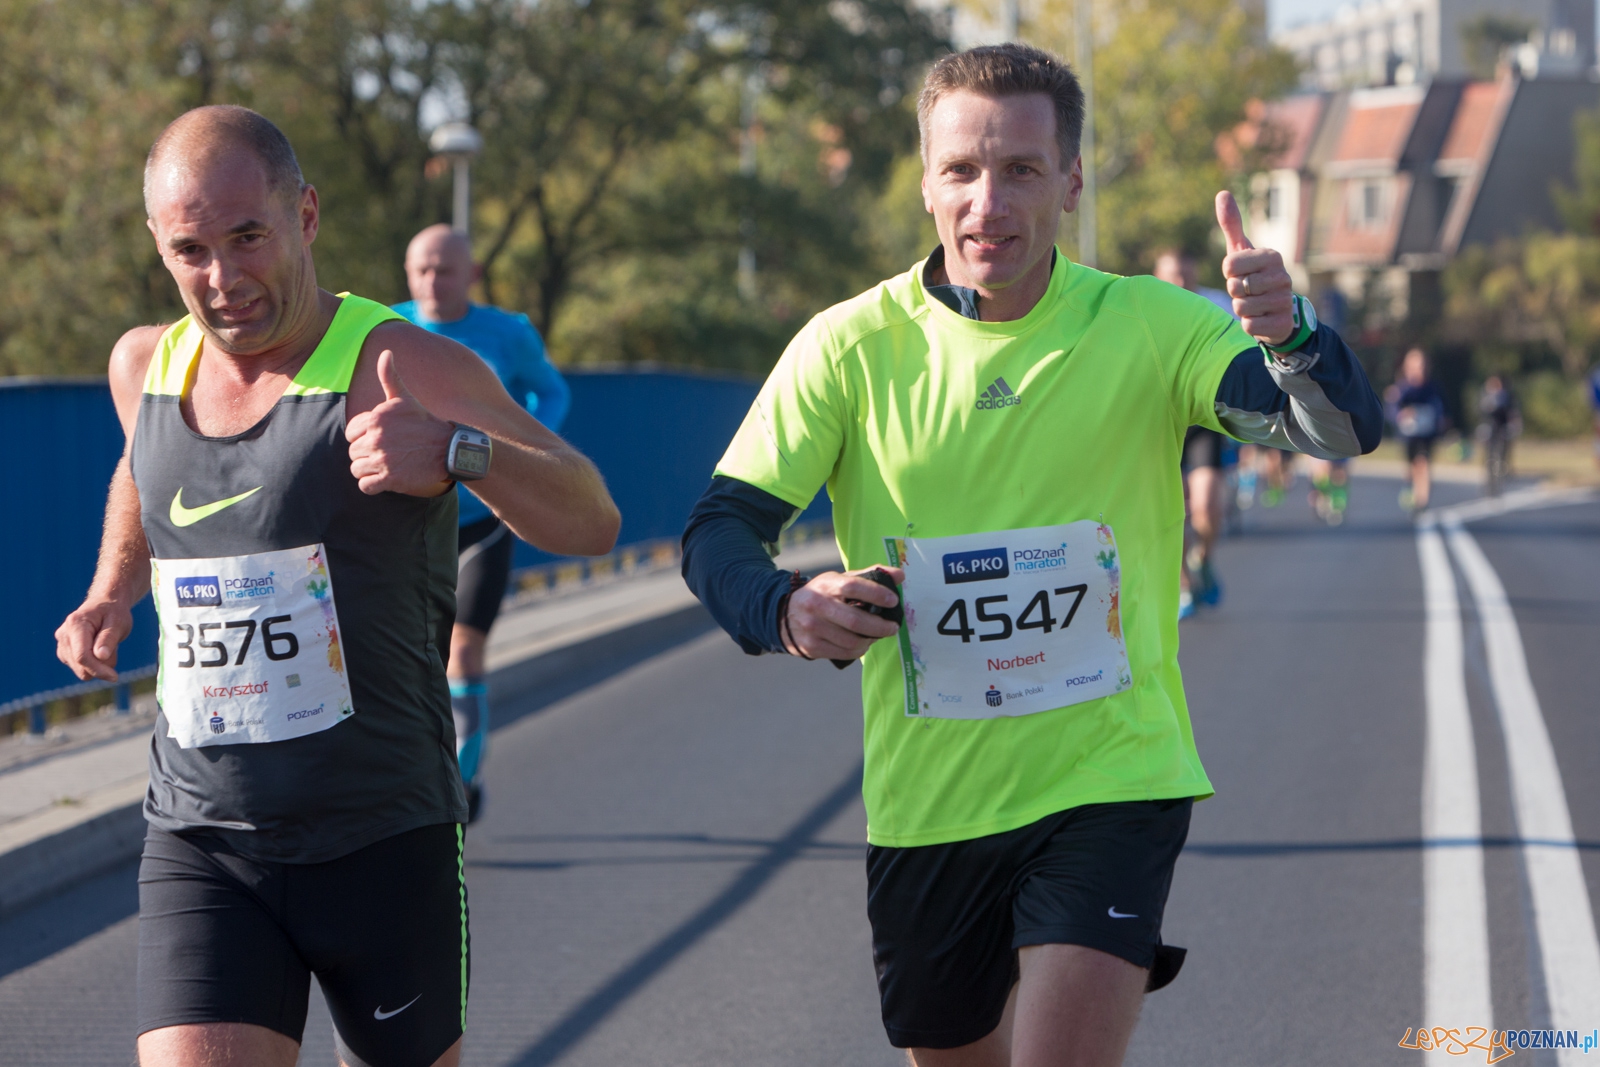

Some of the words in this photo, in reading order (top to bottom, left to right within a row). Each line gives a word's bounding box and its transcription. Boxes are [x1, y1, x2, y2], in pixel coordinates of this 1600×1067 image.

[975, 395, 1022, 410] adidas
[1014, 557, 1066, 571] maraton
[226, 586, 275, 599] maraton
[936, 583, 1088, 643] 4547
[175, 614, 299, 668] 3576
[987, 651, 1046, 671] Norbert
[203, 681, 269, 699] Krzysztof
[1006, 691, 1023, 700] Bank
[1025, 686, 1044, 696] Polski
